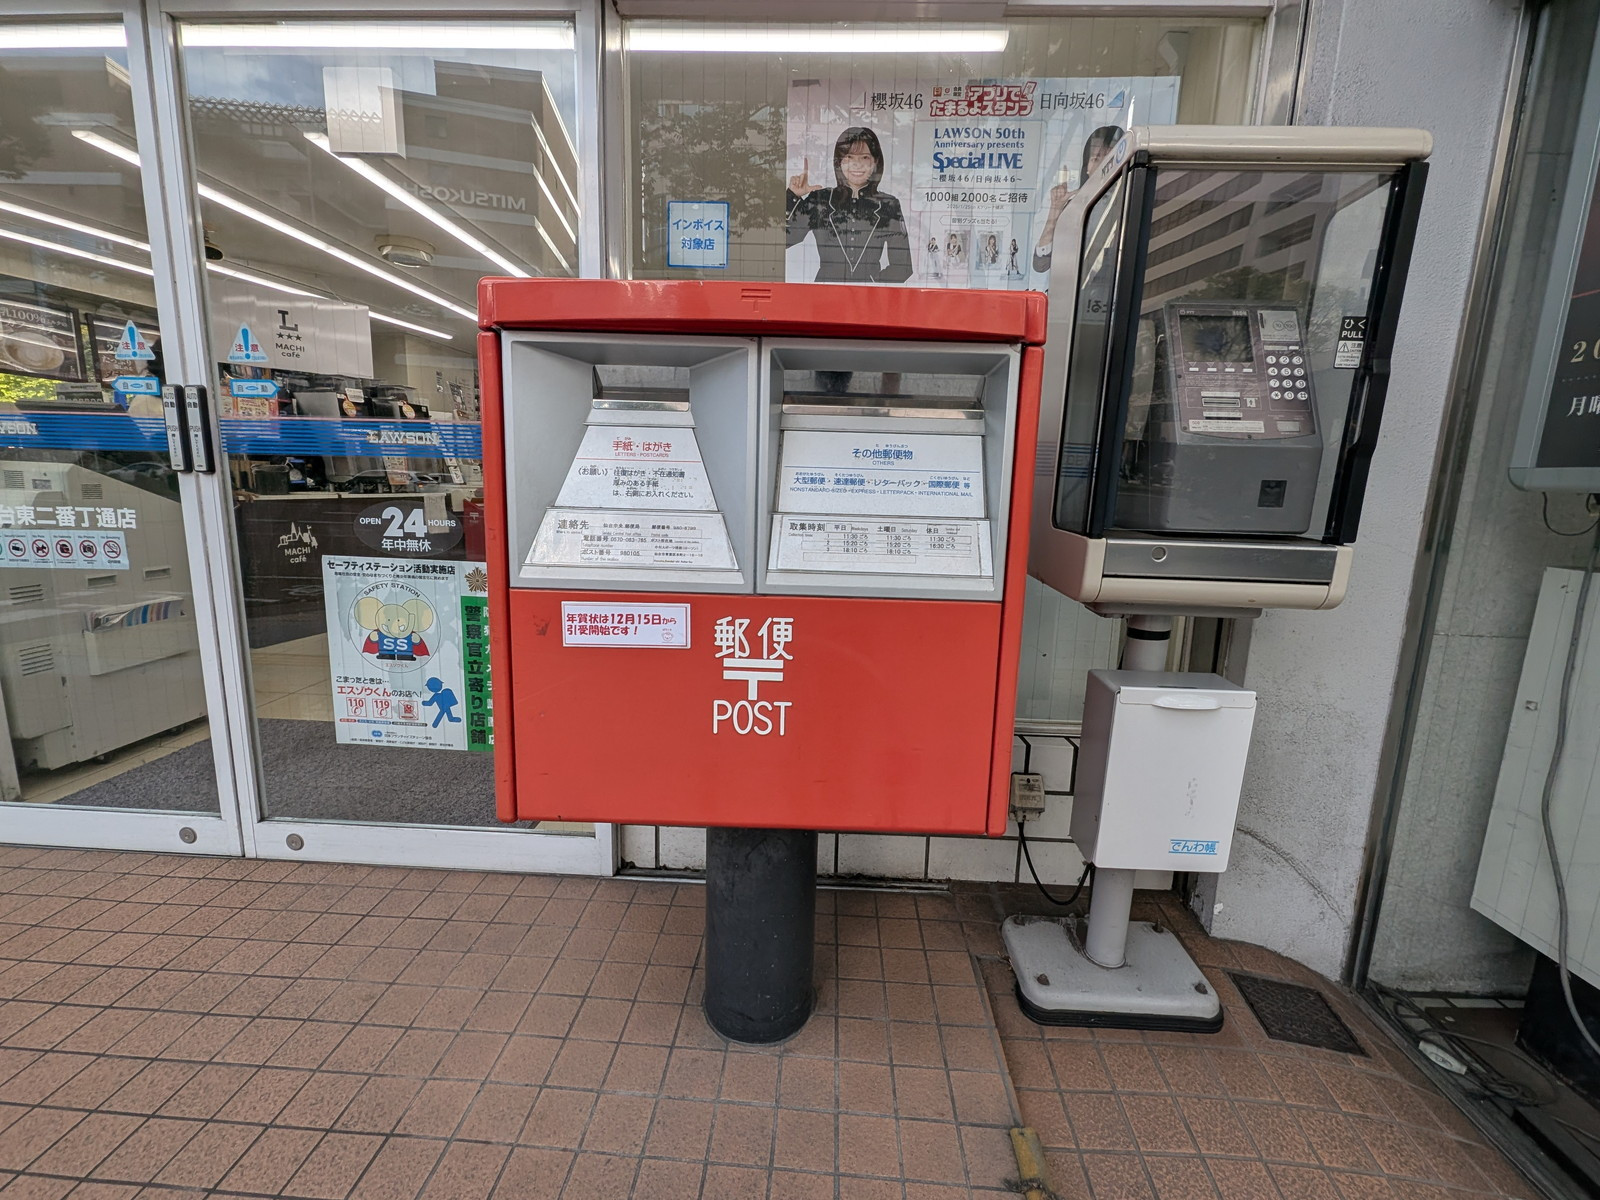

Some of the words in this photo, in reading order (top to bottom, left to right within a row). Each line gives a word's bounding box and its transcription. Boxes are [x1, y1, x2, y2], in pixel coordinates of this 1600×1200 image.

[870, 92, 923, 110] 櫻坂46
[1040, 91, 1104, 110] 日向坂46
[930, 100, 1033, 116] たまるよスタンプ
[934, 128, 992, 139] LAWSON
[996, 128, 1024, 139] 50th
[934, 141, 984, 149] Anniversary
[987, 142, 1024, 150] presents
[932, 152, 985, 172] Special
[988, 152, 1024, 169] LIVE
[672, 218, 724, 230] インボイス
[681, 238, 716, 250] 対象店
[1344, 319, 1366, 329] ひく
[1342, 330, 1363, 338] PULL
[235, 344, 259, 352] 注意
[276, 342, 305, 352] MACHI
[368, 430, 439, 445] LAWSON
[612, 440, 672, 452] 手紙・はがき
[852, 449, 913, 460] その他郵便物
[613, 479, 659, 487] 厚みのある手紙
[0, 504, 136, 529] 台東二番丁通店
[382, 506, 428, 538] 24
[428, 519, 456, 527] HOURS
[558, 519, 589, 529] 連絡先
[790, 522, 826, 531] 取集時刻
[381, 538, 431, 552] 年中無休
[284, 547, 311, 556] MACHI
[327, 561, 456, 575] セーフティステーション活動実施店
[363, 582, 389, 596] SAFETY
[391, 583, 421, 598] STATION
[566, 613, 677, 625] 年賀状は12月15日から
[714, 616, 794, 660] 郵便
[464, 605, 486, 744] 警察官立寄り店舗
[348, 699, 364, 708] 110
[374, 699, 390, 709] 119
[712, 699, 793, 736] POST
[1171, 841, 1217, 853] でんわ帳
